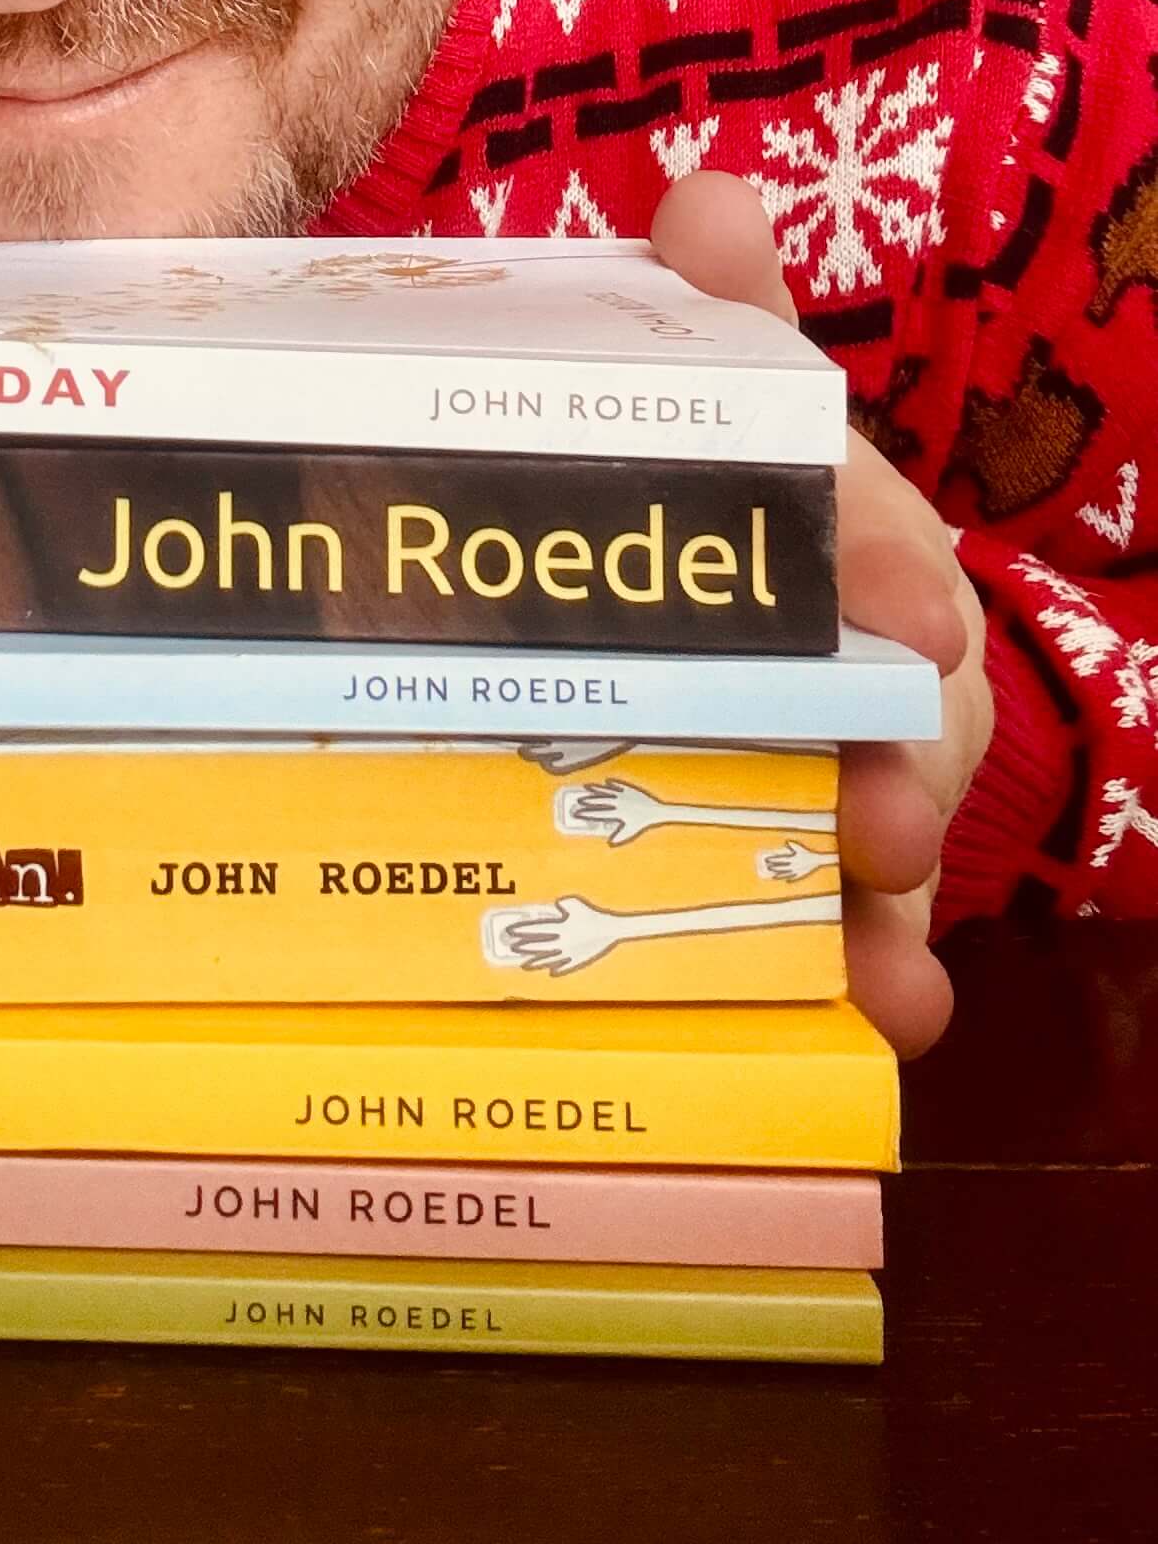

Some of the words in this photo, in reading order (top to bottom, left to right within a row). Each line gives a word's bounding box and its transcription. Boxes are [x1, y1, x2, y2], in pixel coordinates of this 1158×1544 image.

[429, 388, 542, 422] JOHN
[568, 393, 733, 426] ROEDEL
[78, 491, 343, 593] John
[387, 503, 776, 607] Roedel
[343, 675, 448, 702] JOHN
[472, 677, 628, 705] ROEDEL
[150, 861, 279, 896] JOHN
[319, 861, 516, 896] ROEDEL
[295, 1094, 424, 1128] JOHN
[453, 1097, 648, 1133] ROEDEL
[184, 1184, 319, 1221] JOHN
[350, 1189, 551, 1229] ROEDEL
[225, 1302, 324, 1327] JOHN
[351, 1304, 502, 1332] ROEDEL
